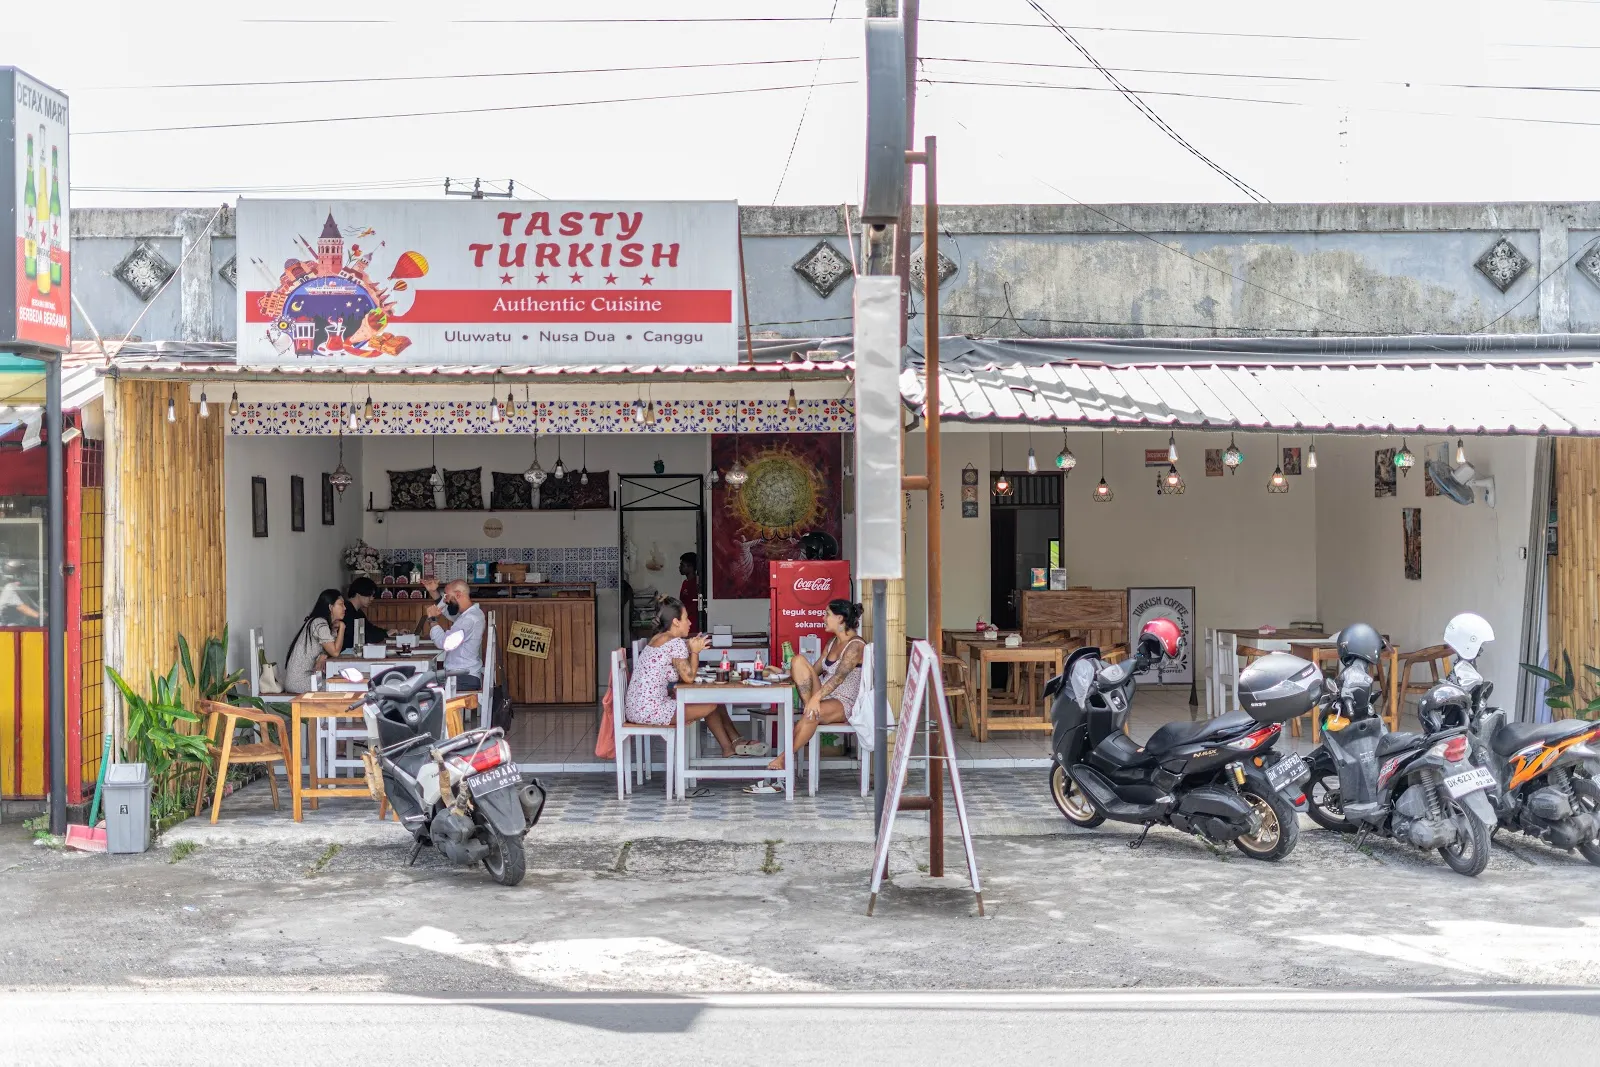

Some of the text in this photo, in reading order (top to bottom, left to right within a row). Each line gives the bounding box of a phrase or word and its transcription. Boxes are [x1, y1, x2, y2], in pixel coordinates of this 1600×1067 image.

[17, 82, 67, 127] DETAX MART
[497, 211, 643, 241] TASTY
[468, 243, 680, 268] TURKISH
[492, 297, 662, 312] Authentic Cuisine
[444, 331, 703, 345] Uluwatu Nusa Dua Canggu
[794, 577, 832, 591] Coca-Cola
[782, 608, 827, 617] teguk sega
[1132, 596, 1188, 617] TURKISH COFFEE
[795, 620, 827, 628] sekaran
[512, 636, 546, 653] OPEN
[470, 765, 517, 787] DK 4679 AAV
[1447, 778, 1459, 788] DK
